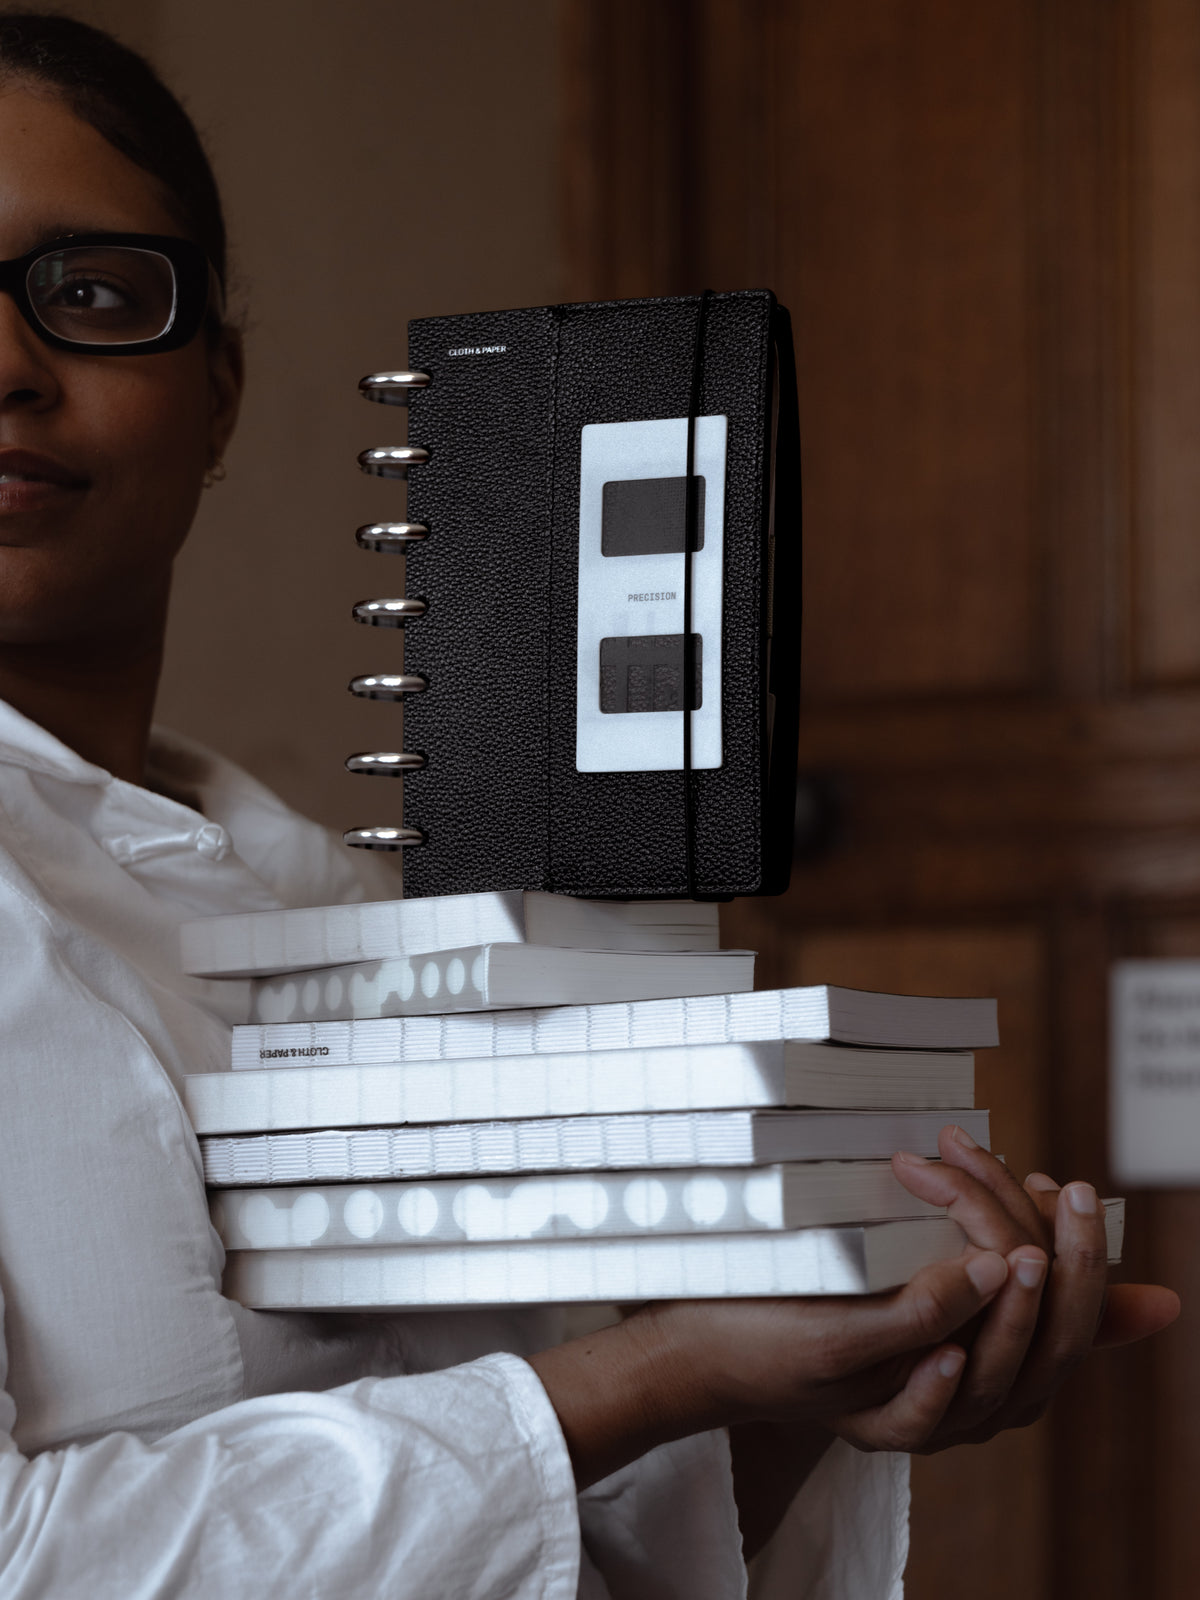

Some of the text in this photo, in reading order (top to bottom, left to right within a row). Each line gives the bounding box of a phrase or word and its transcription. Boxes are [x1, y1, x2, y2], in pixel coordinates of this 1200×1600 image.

[448, 345, 507, 357] CLOTH & PAPER
[627, 591, 677, 602] PRECISION
[259, 1047, 329, 1059] CLOTH & PAPER
